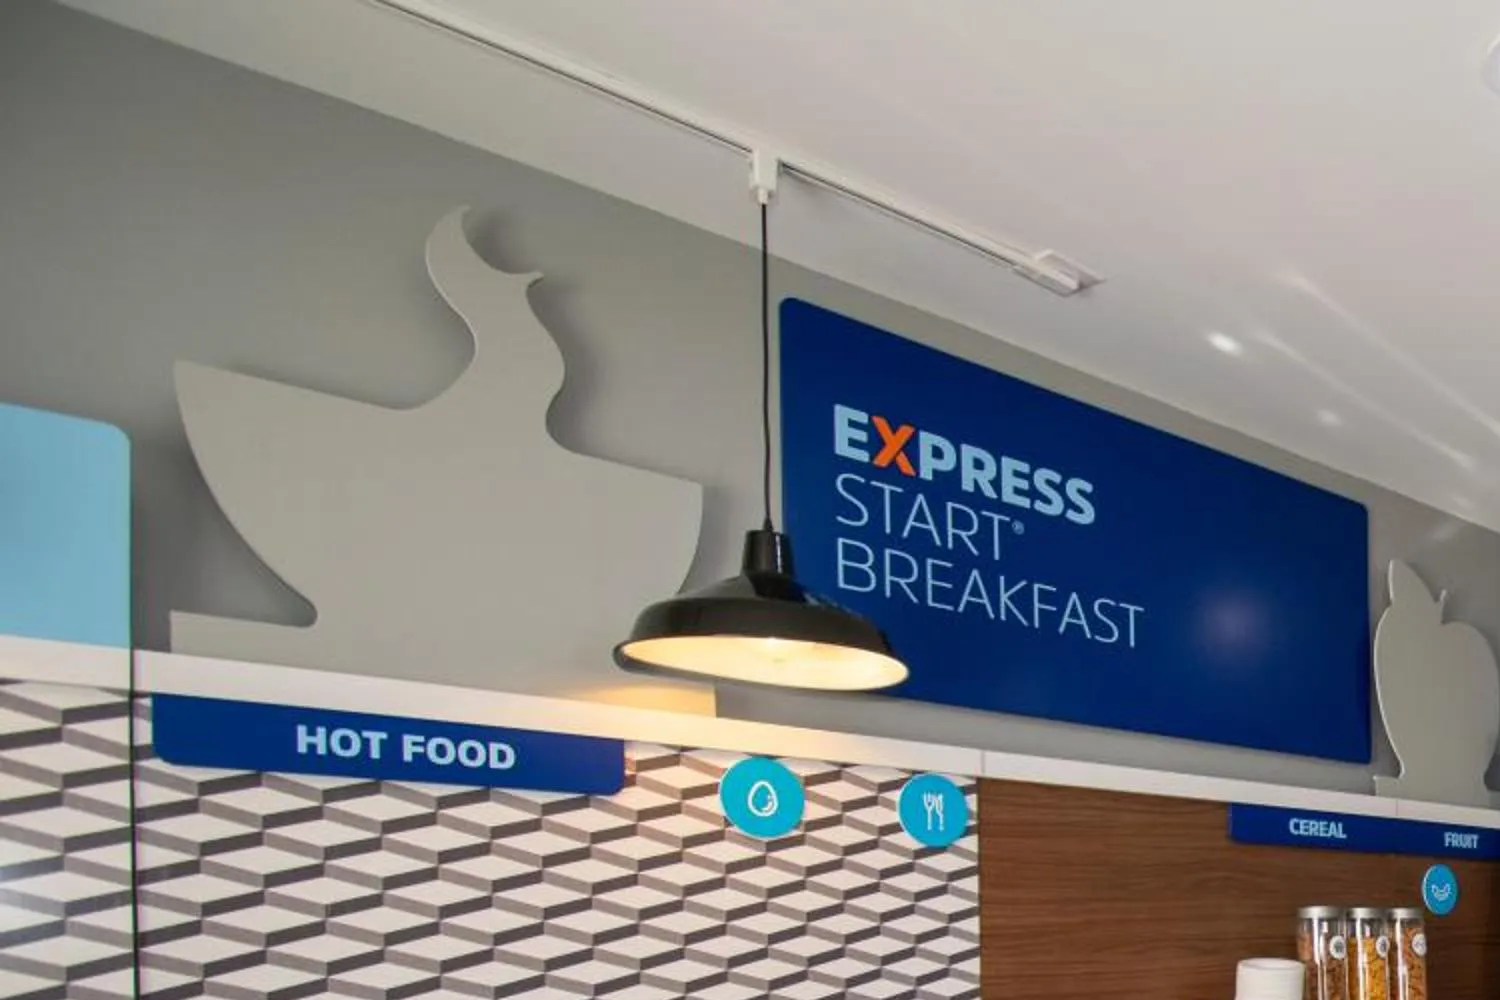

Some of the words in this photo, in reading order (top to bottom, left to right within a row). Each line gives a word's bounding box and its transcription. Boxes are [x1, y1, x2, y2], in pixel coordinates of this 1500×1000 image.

[834, 404, 1096, 525] EXPRESS
[837, 537, 1145, 649] BREAKFAST
[296, 723, 388, 760] HOT
[402, 733, 516, 770] FOOD
[1289, 817, 1348, 840] CEREAL
[1443, 831, 1480, 849] FRUIT
